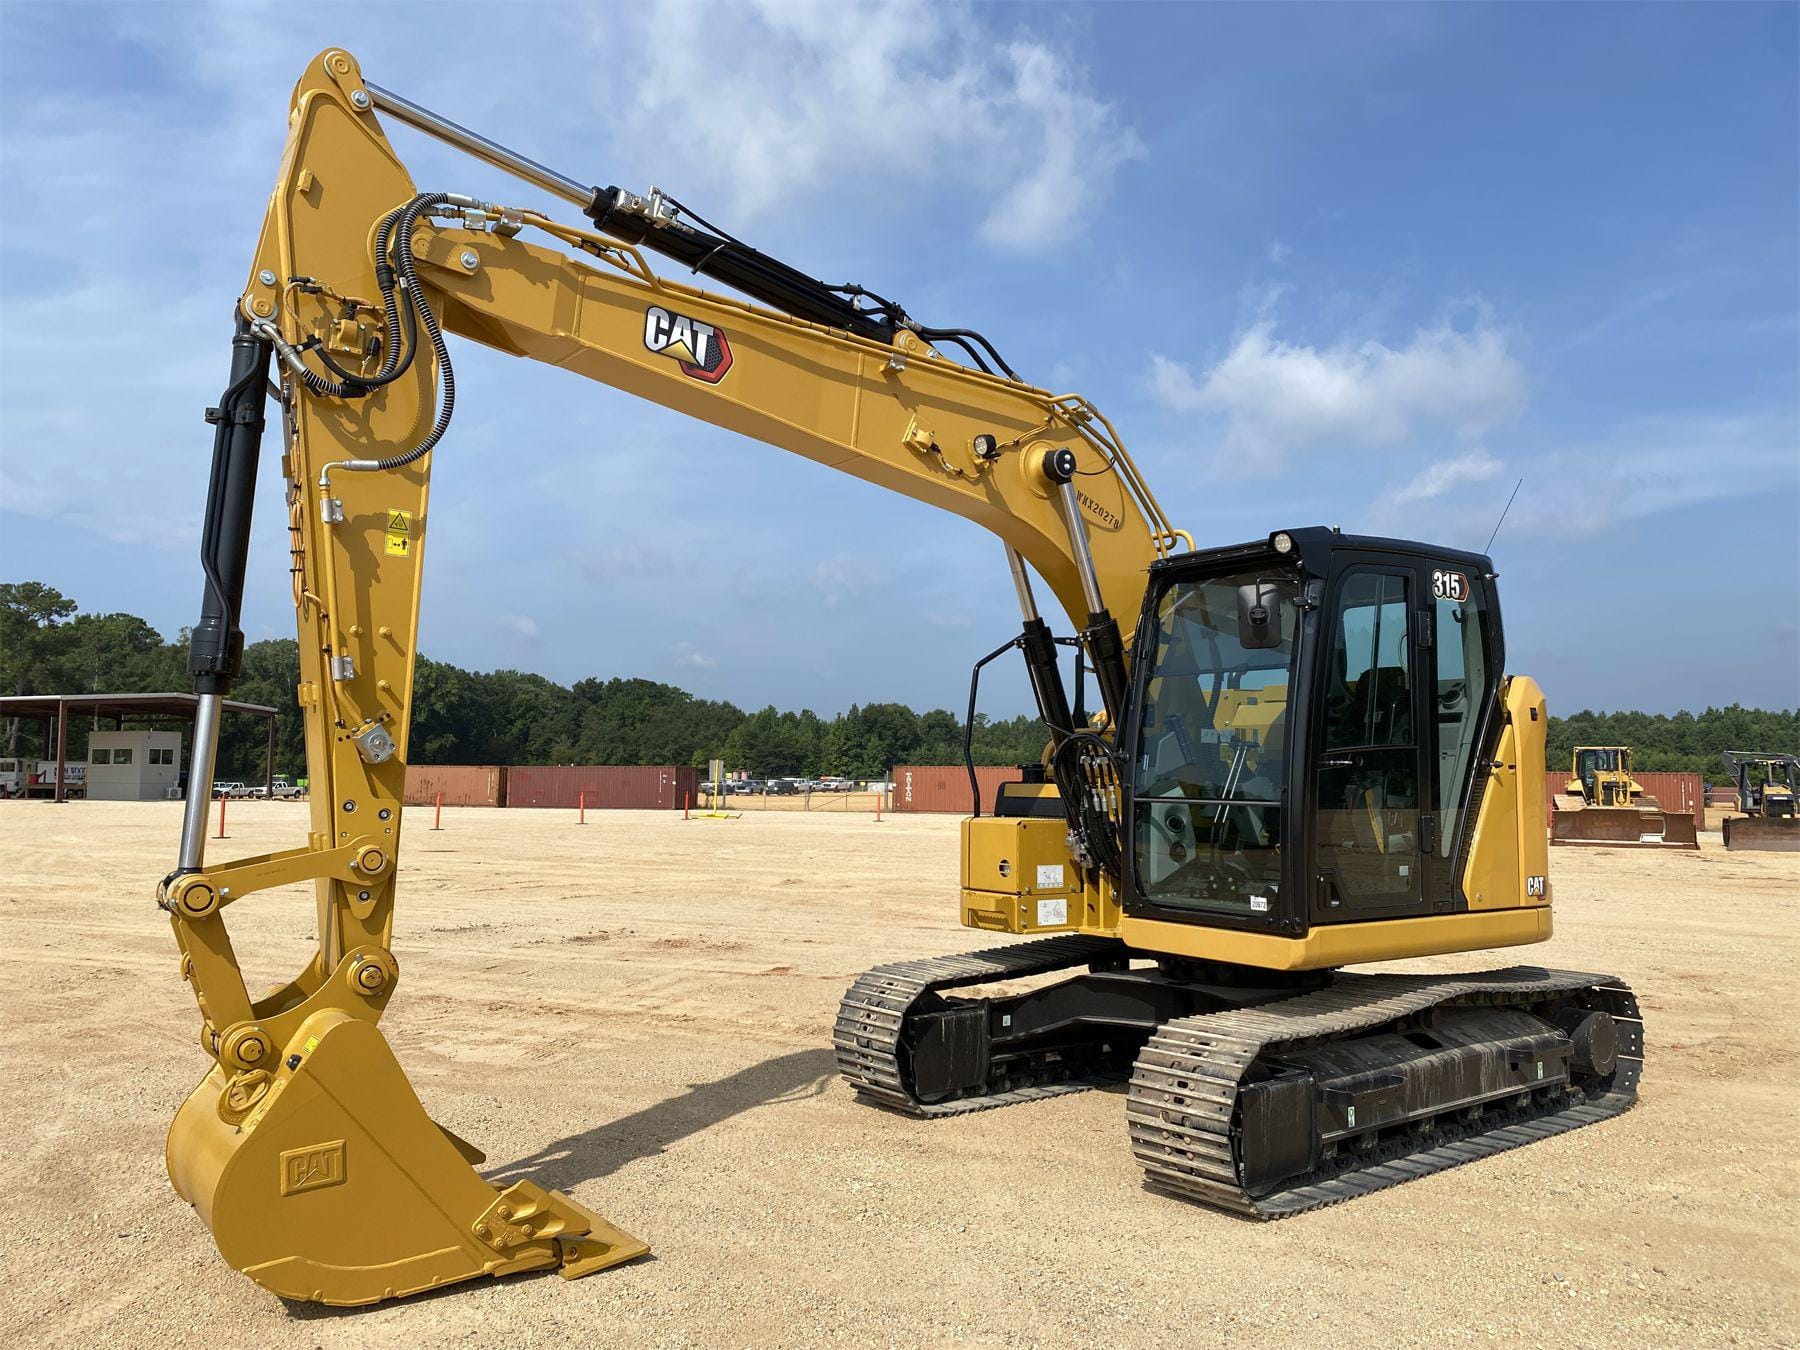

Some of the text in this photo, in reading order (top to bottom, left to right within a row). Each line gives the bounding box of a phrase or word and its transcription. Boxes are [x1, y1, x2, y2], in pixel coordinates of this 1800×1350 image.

[646, 307, 714, 367] CAT
[1434, 571, 1460, 598] 315
[1527, 876, 1544, 896] CAT
[287, 1147, 341, 1188] CAT
